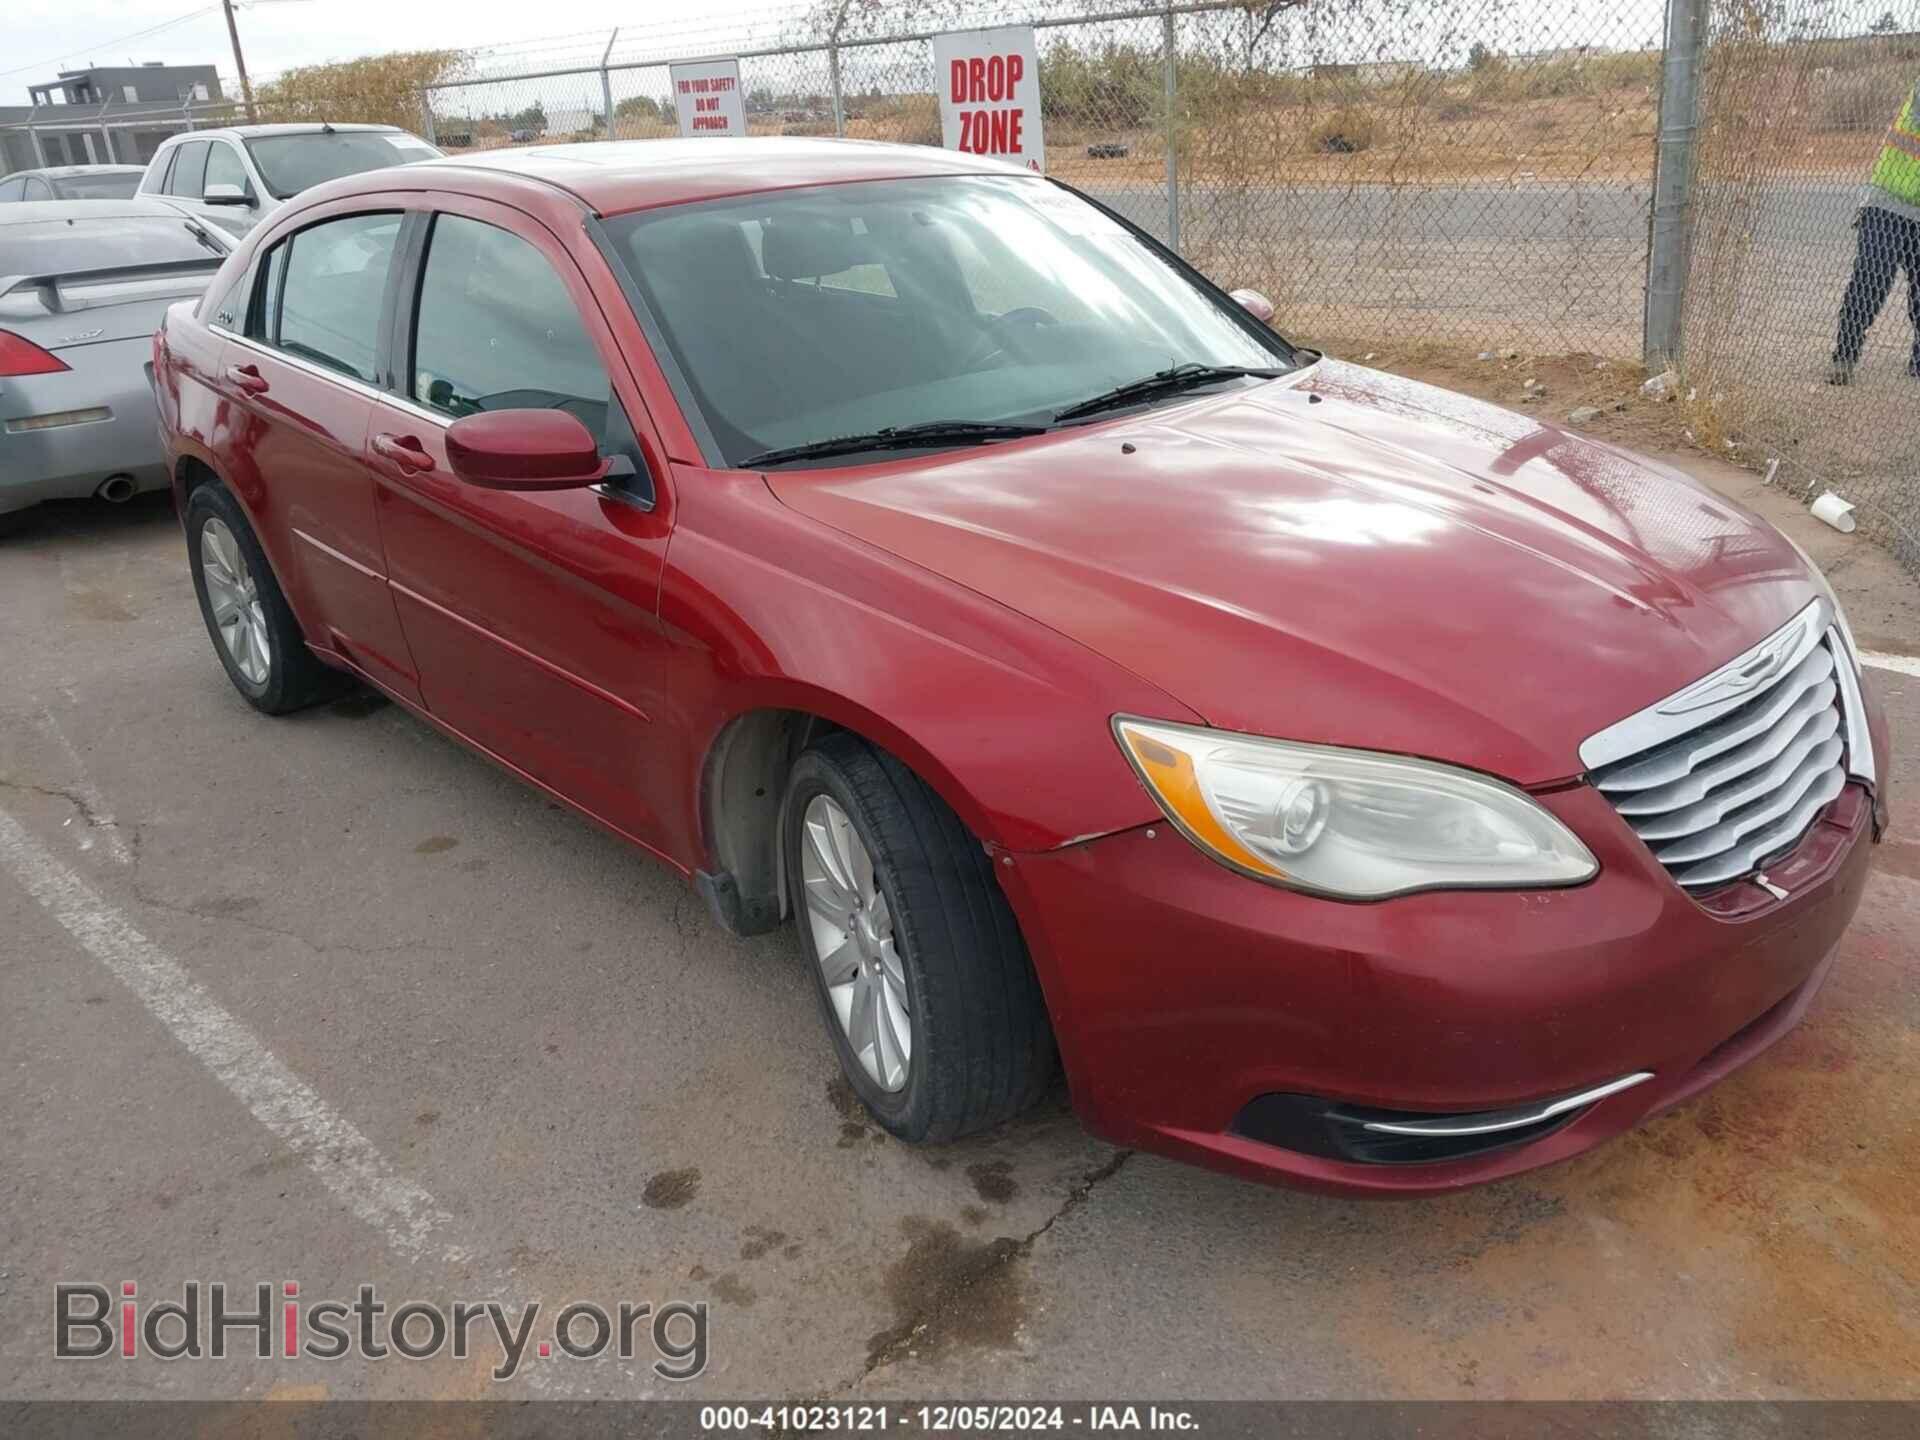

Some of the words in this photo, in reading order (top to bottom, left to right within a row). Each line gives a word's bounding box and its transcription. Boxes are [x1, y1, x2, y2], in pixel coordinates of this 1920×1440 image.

[677, 79, 691, 95] FOR
[691, 79, 709, 94] YOUR
[710, 76, 736, 92] SAFETY
[951, 54, 1024, 104] DROP
[696, 98, 705, 112] DO
[706, 97, 720, 111] NOT
[692, 115, 728, 130] APPROACH
[959, 109, 1023, 154] ZONE
